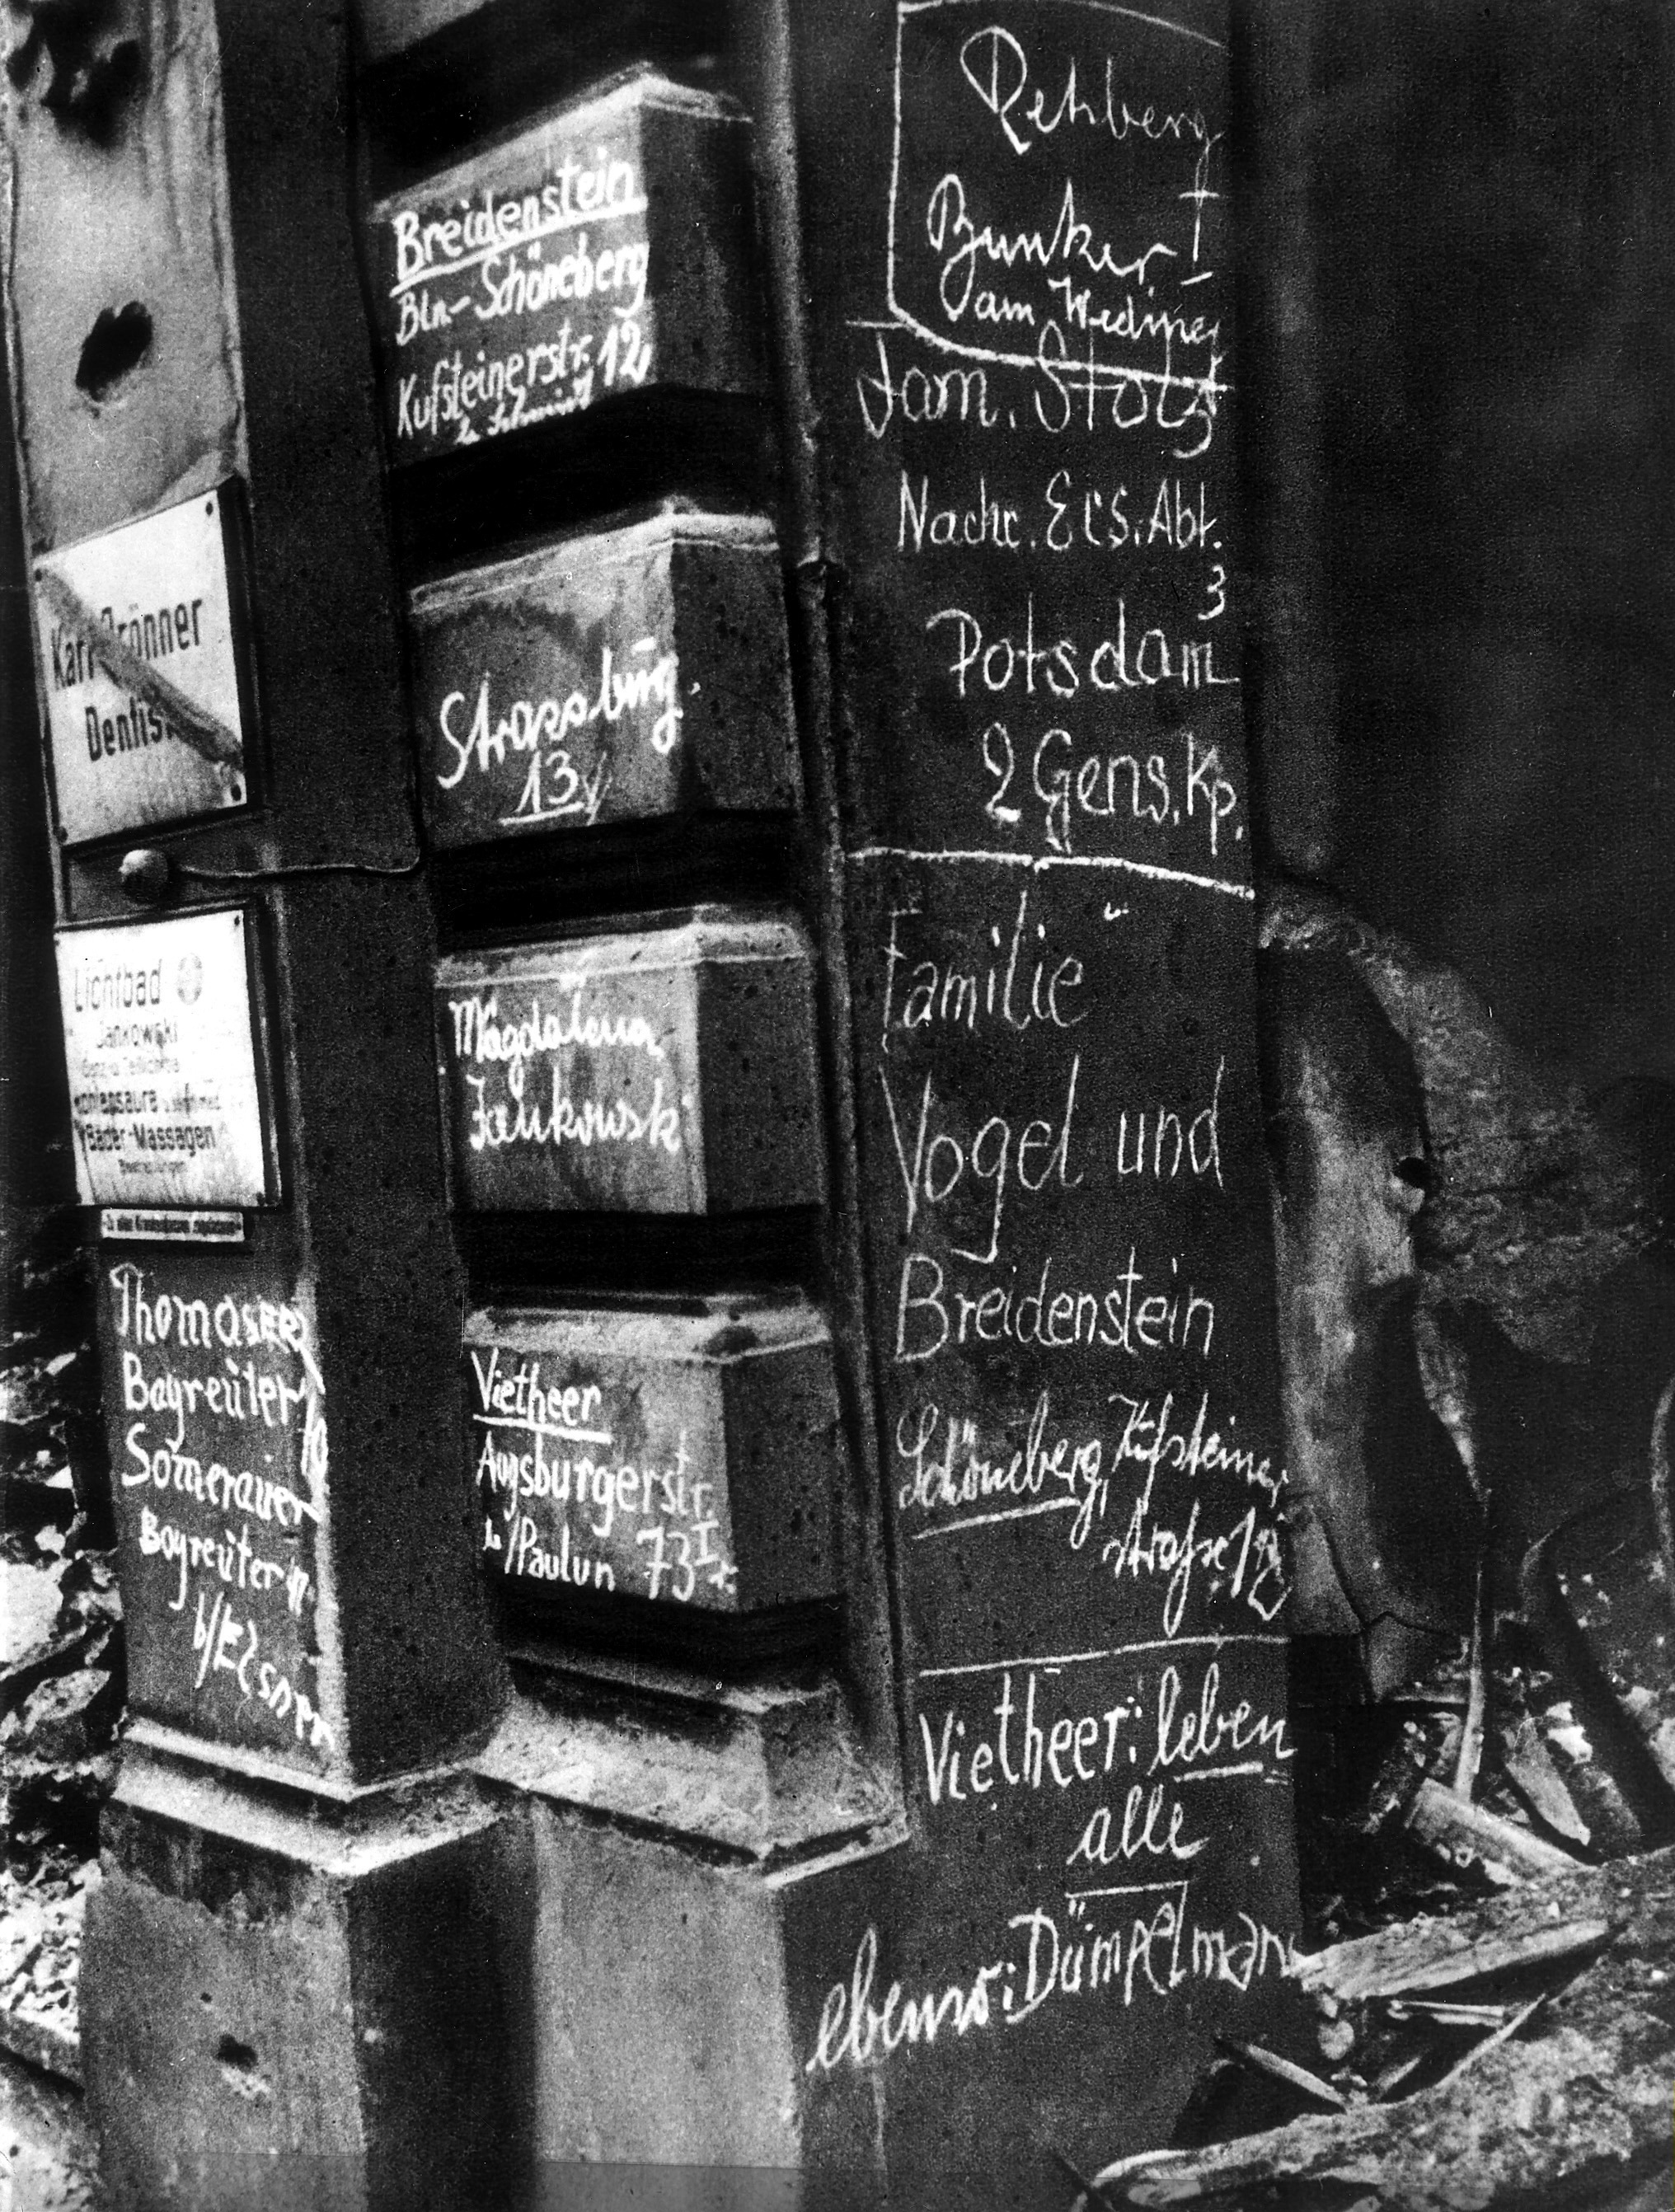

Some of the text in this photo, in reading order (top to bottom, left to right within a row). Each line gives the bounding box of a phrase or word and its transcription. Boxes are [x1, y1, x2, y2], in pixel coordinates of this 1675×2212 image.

[392, 147, 636, 282] Breidenstein
[926, 592, 1240, 698] Potsdam
[85, 696, 174, 762] Dentis
[880, 890, 1086, 1053] Familie
[879, 1055, 1227, 1265] Vogel und
[895, 1246, 1216, 1362] Breidenstein
[470, 1347, 603, 1426] Vietheer
[1147, 1662, 1299, 1775] leben
[1067, 1783, 1212, 1866] alle
